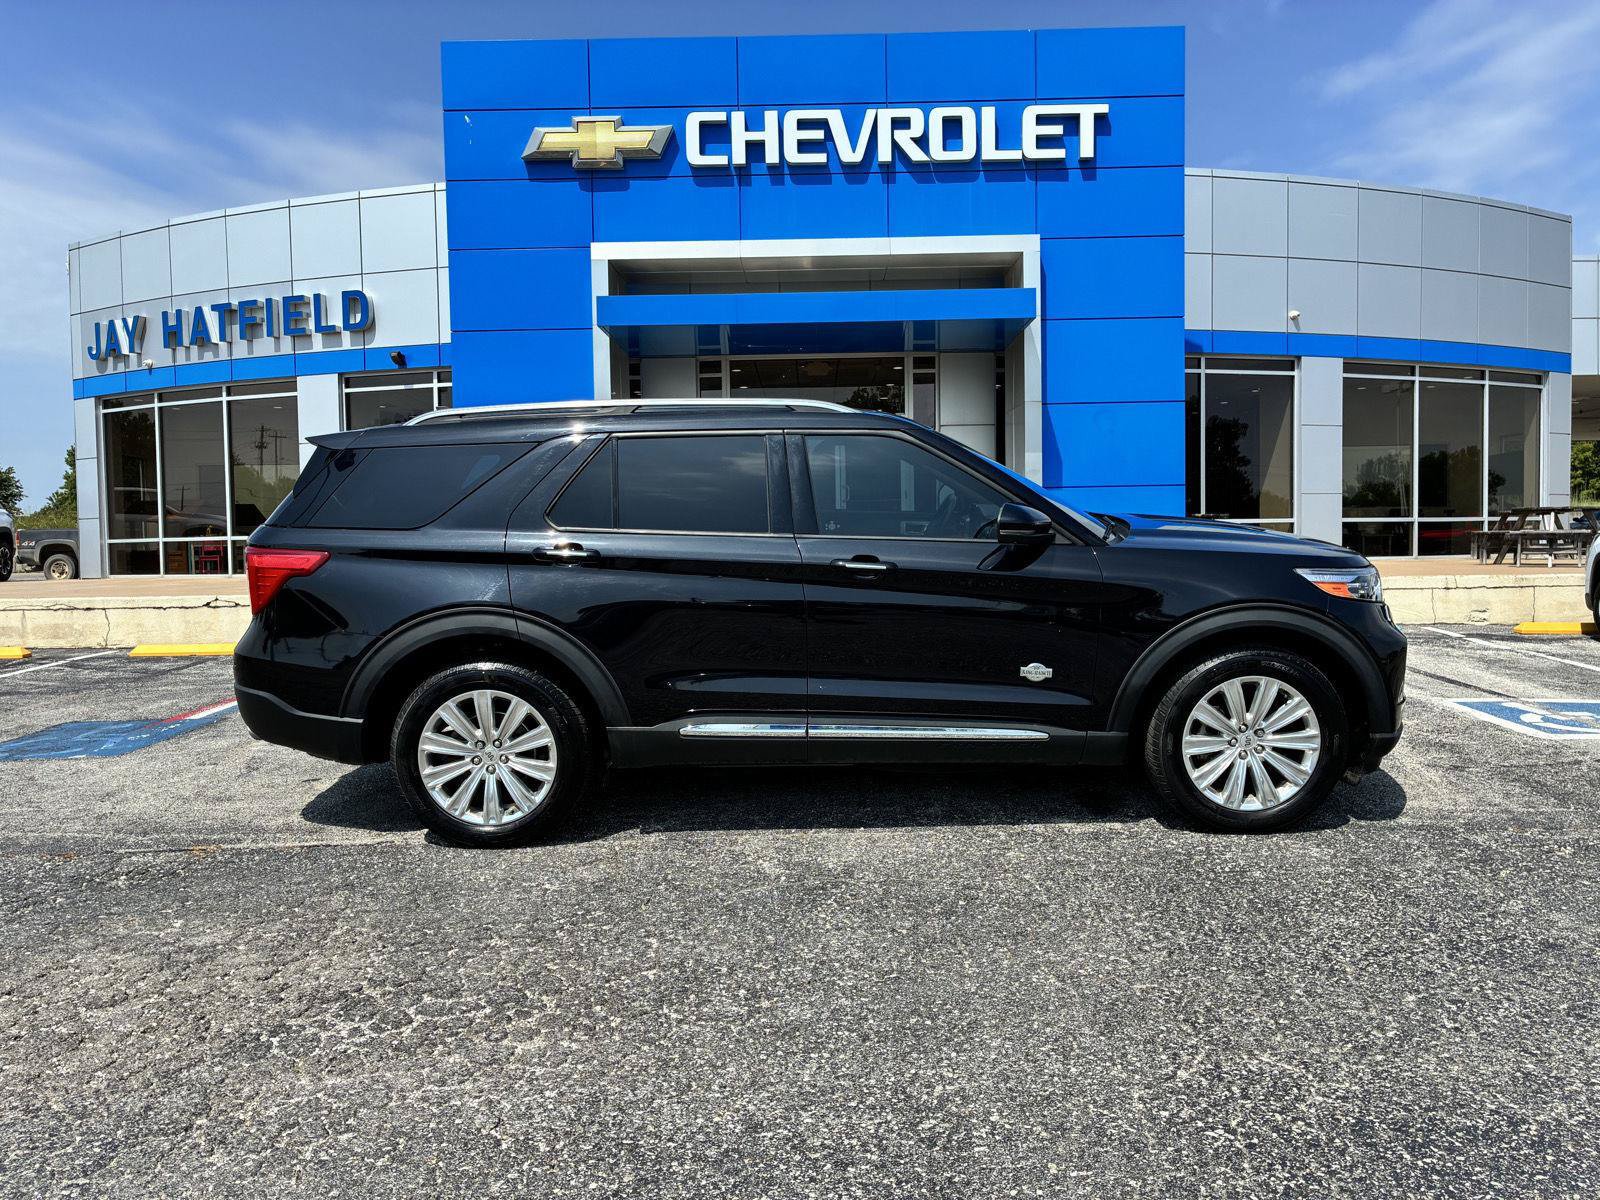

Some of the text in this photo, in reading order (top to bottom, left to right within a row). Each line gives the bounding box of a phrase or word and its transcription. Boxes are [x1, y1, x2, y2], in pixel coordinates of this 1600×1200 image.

[685, 103, 1110, 168] CHEVROLET
[87, 289, 373, 361] JAY HATFIELD
